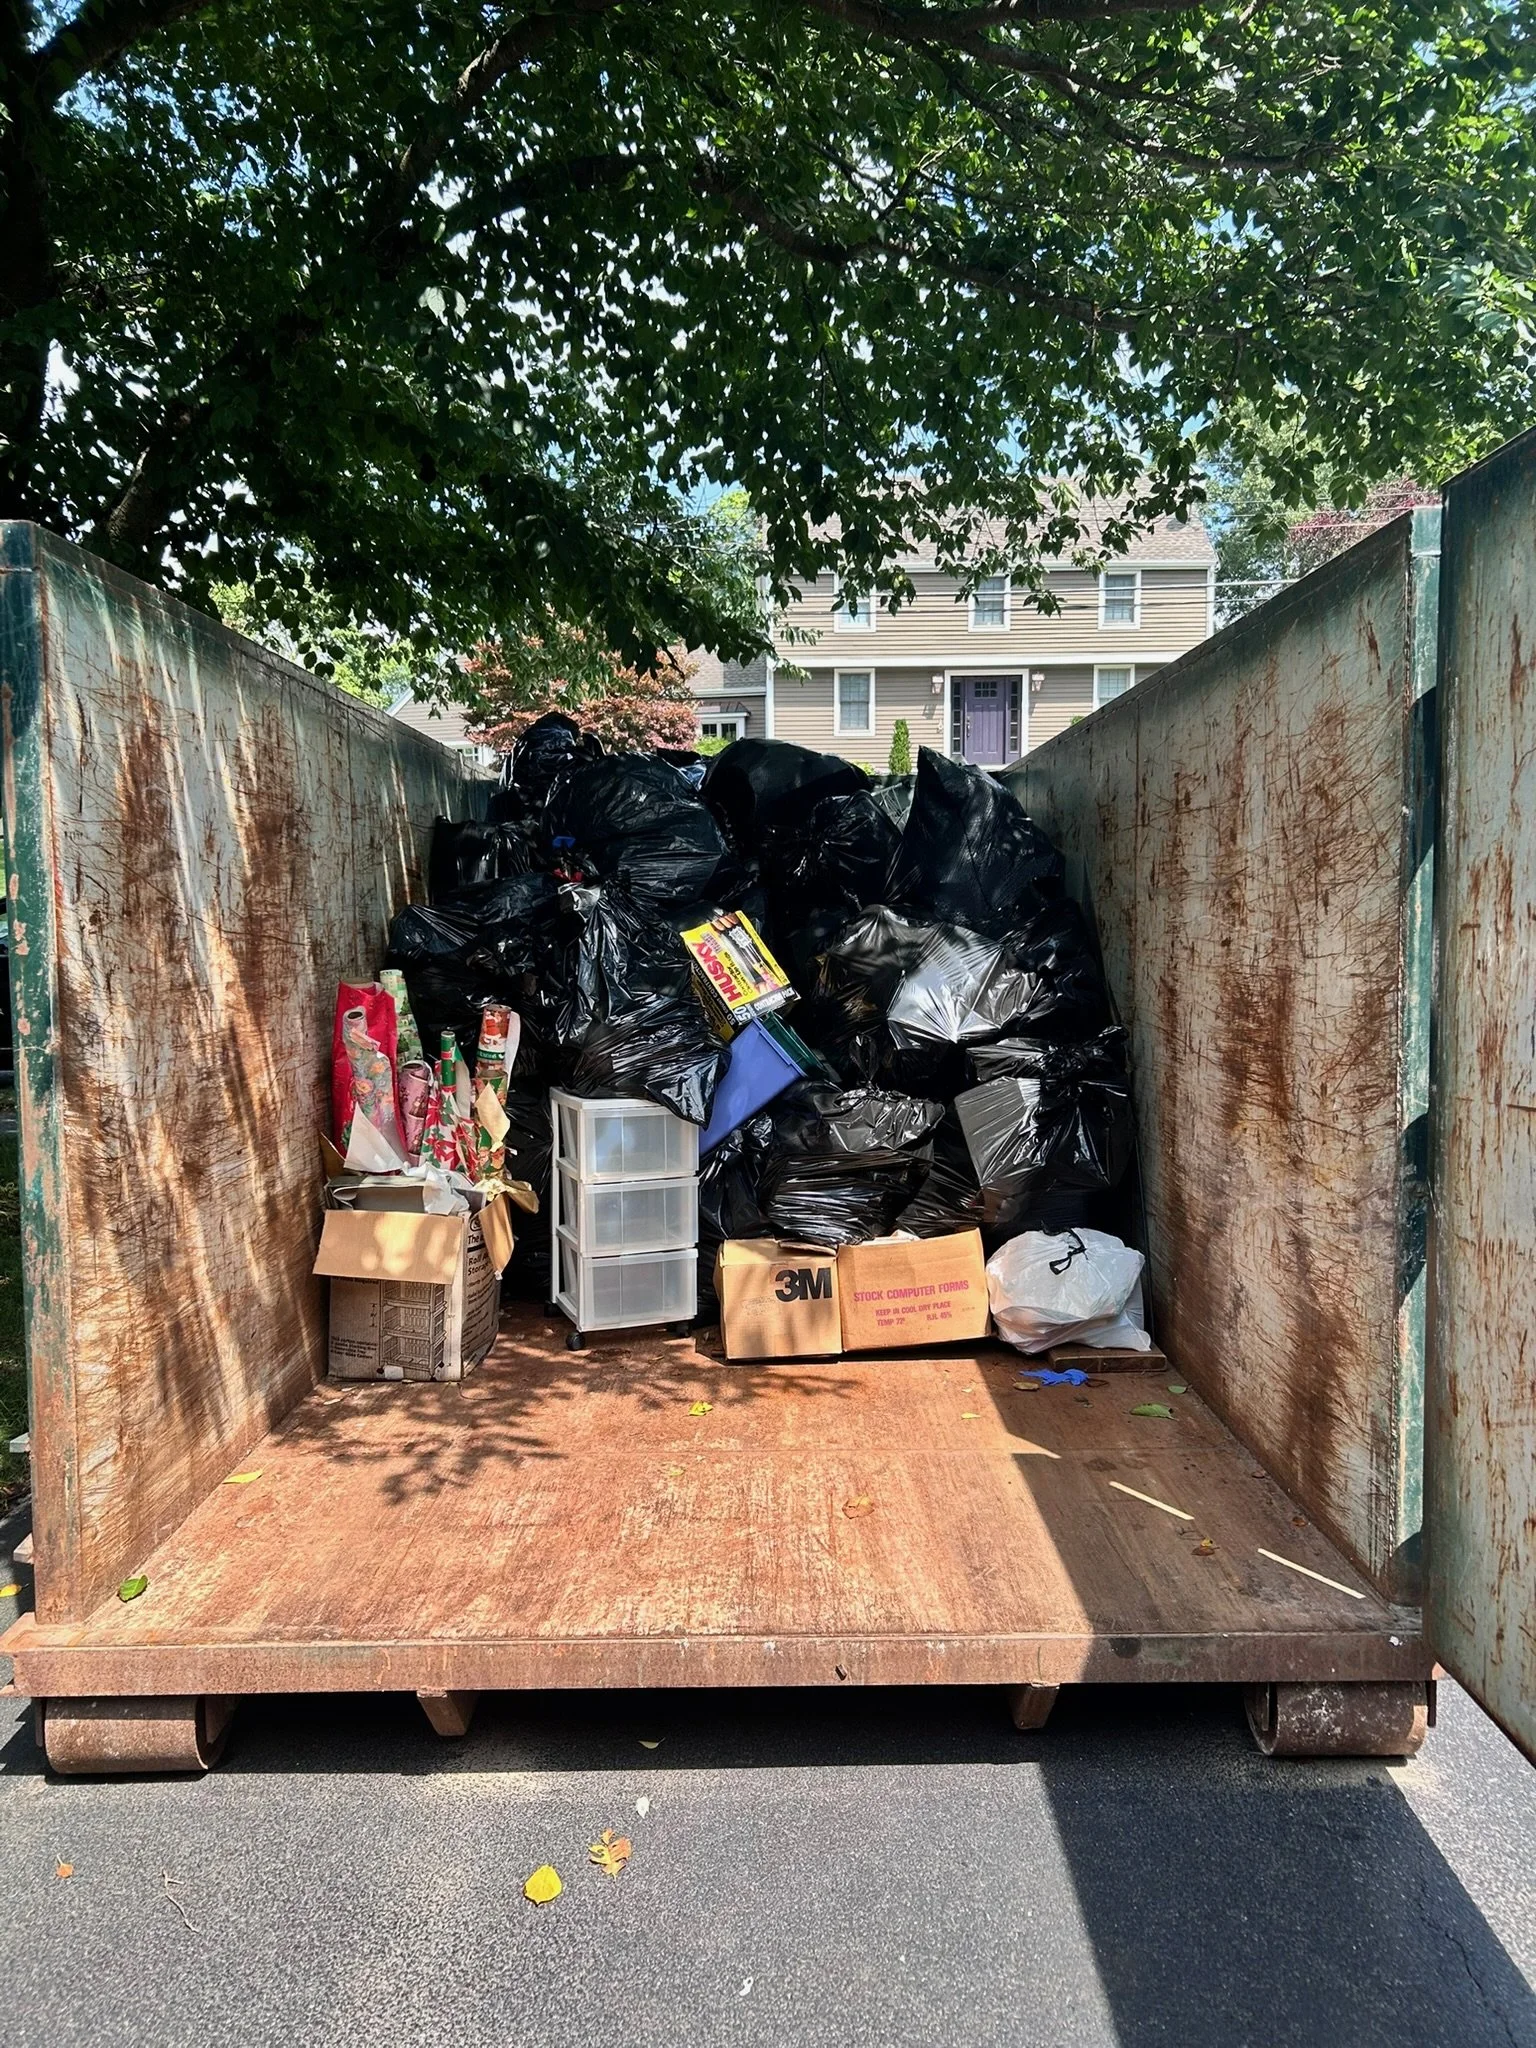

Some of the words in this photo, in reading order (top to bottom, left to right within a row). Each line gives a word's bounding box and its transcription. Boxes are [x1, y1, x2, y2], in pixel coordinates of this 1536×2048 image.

[691, 942, 743, 1002] HUSKY
[733, 1005, 751, 1021] 50
[775, 1267, 832, 1302] 3M
[854, 1291, 884, 1302] STOCK
[886, 1285, 936, 1300] COMPUTER
[938, 1280, 970, 1293] FORMS
[875, 1308, 891, 1317] KEEP
[892, 1307, 900, 1315] IN
[901, 1305, 917, 1314] COOL
[918, 1303, 931, 1312] DRY
[932, 1301, 951, 1309] PLACE
[877, 1318, 894, 1327] TEMP
